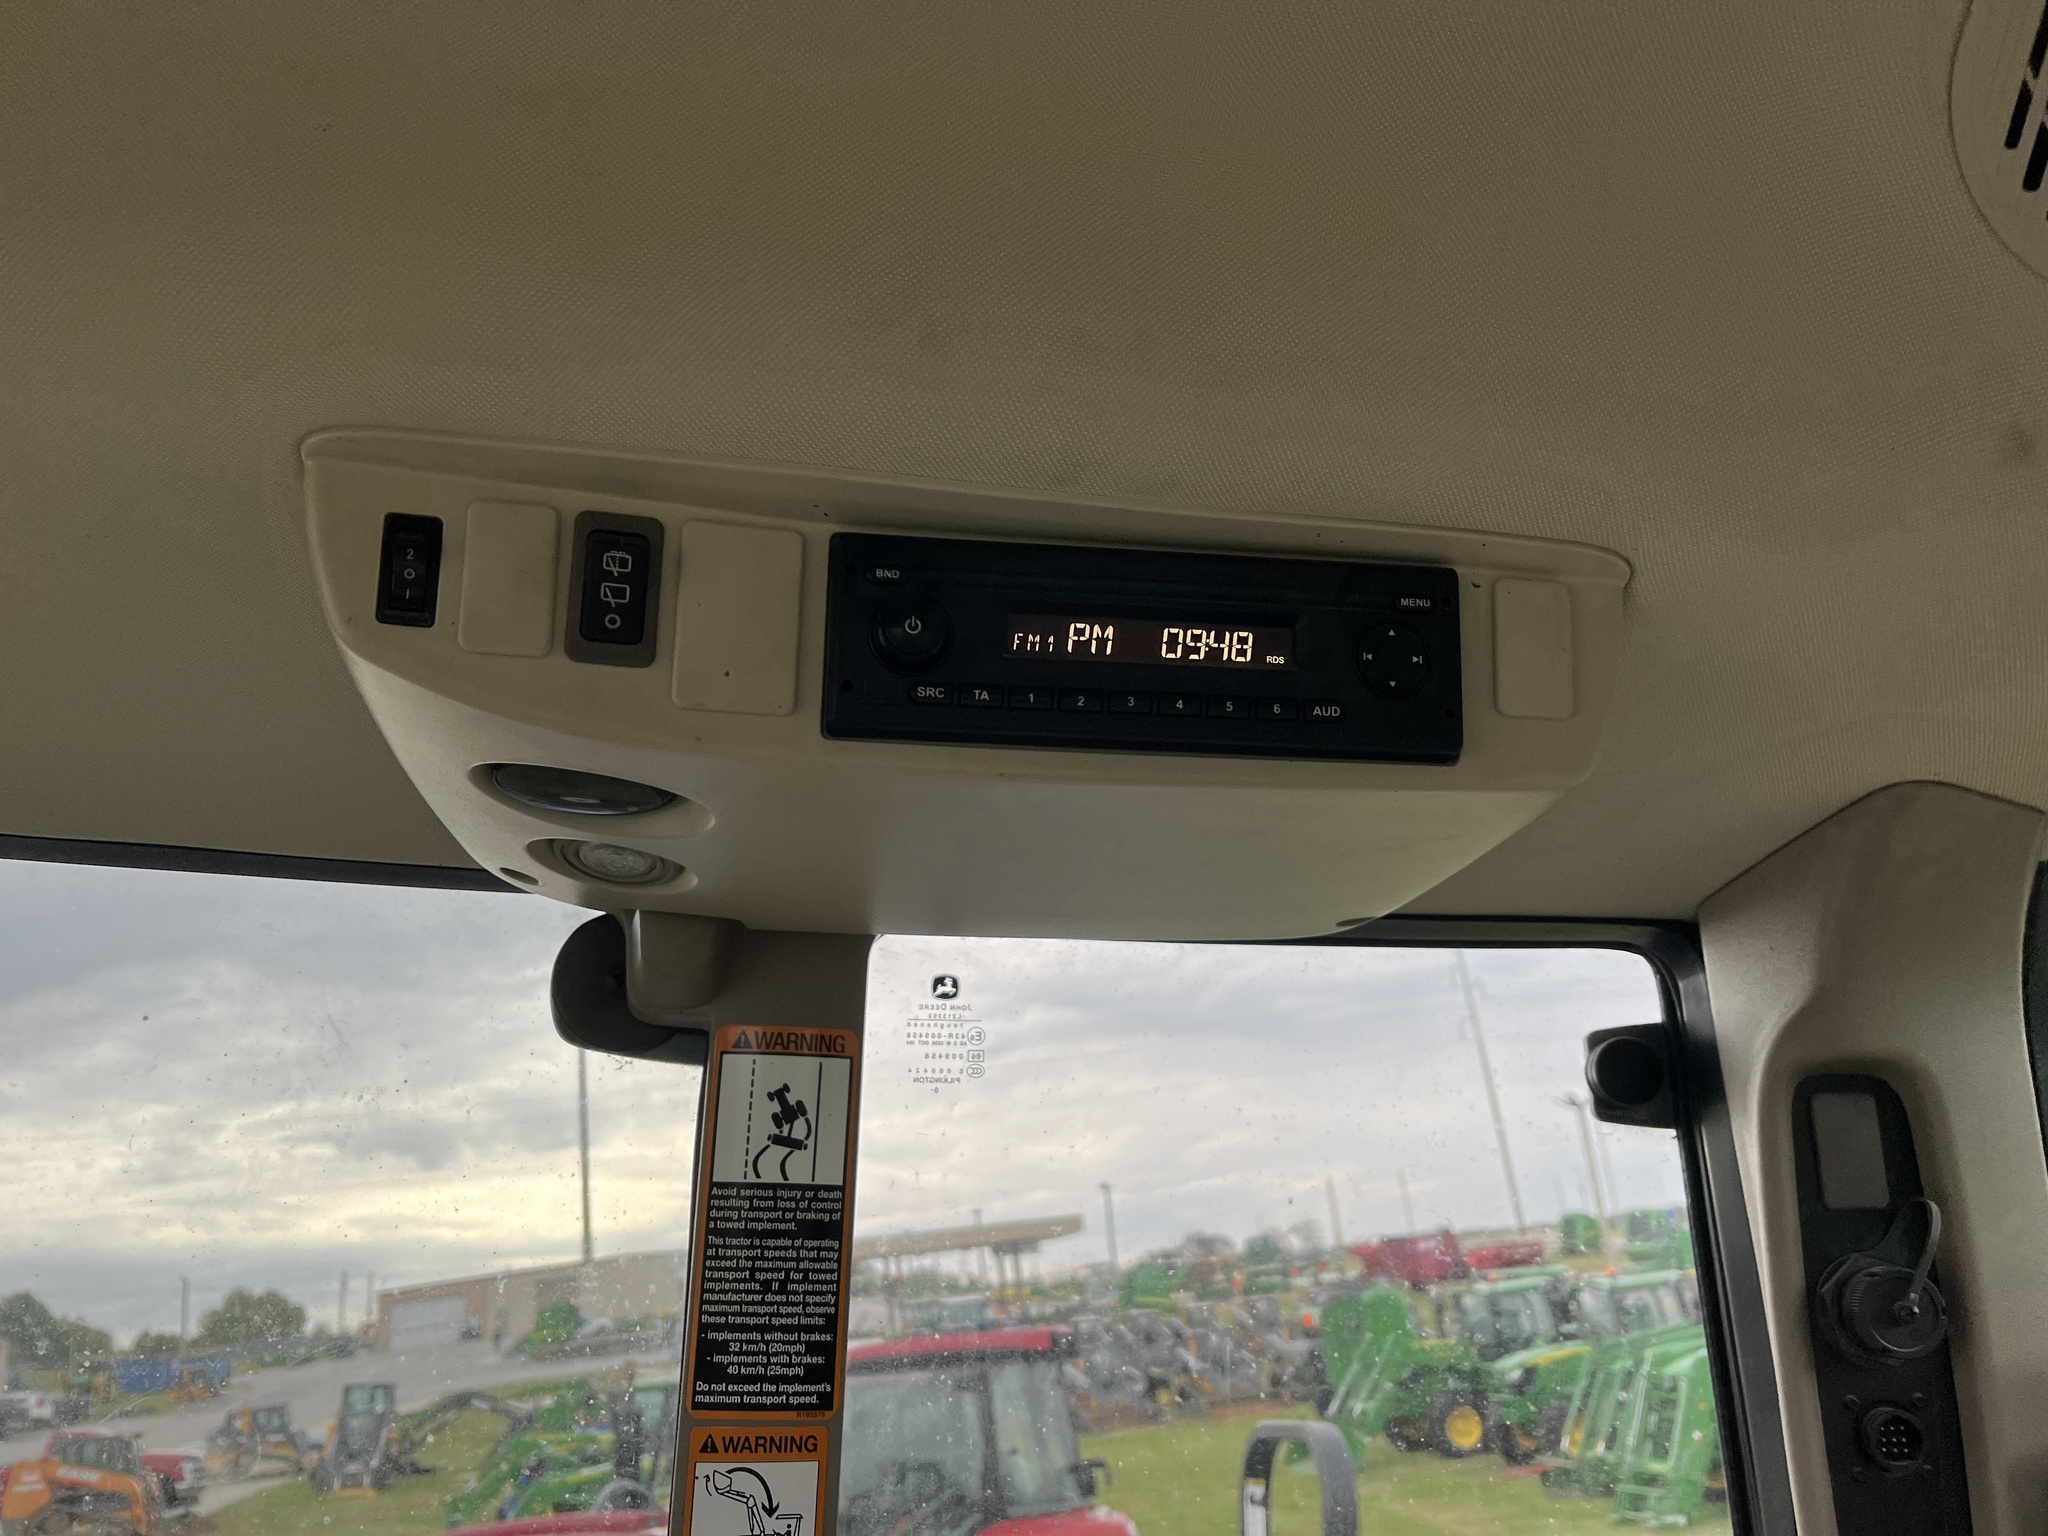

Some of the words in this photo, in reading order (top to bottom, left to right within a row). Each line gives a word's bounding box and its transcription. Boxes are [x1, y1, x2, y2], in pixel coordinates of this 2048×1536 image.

[407, 549, 414, 560] 2
[876, 569, 899, 578] BND
[1400, 598, 1430, 607] MENU
[1013, 633, 1054, 652] FM1
[1067, 622, 1114, 655] PM
[1266, 655, 1285, 664] RDS
[917, 686, 945, 698] SRC
[973, 690, 990, 701] TA
[1028, 693, 1034, 703] 1
[1078, 696, 1084, 706] 2
[1127, 696, 1134, 707] 3
[1176, 700, 1184, 710] 4
[1226, 702, 1233, 712] 5
[1274, 704, 1281, 714] 6
[1312, 706, 1340, 717] AUD
[754, 1031, 845, 1053] WARNING
[711, 1187, 736, 1196] Avoid
[740, 1187, 773, 1196] serious
[777, 1188, 802, 1199] injury
[818, 1189, 842, 1198] death
[711, 1198, 749, 1208] resulting
[753, 1199, 774, 1208] from
[777, 1200, 795, 1208] loss
[799, 1200, 808, 1208] of
[811, 1201, 842, 1209] control
[710, 1209, 738, 1219] during
[741, 1210, 782, 1220] transport
[797, 1211, 829, 1221] braking
[832, 1212, 841, 1220] of
[717, 1220, 744, 1228] towed
[748, 1221, 797, 1231] implement.
[708, 1236, 723, 1245] This
[726, 1236, 752, 1245] tractor
[753, 1237, 760, 1245] is
[762, 1237, 792, 1247] capable
[794, 1238, 802, 1246] of
[804, 1239, 839, 1249] operating
[719, 1248, 761, 1258] transport
[764, 1249, 797, 1258] speeds
[800, 1250, 817, 1258] that
[820, 1252, 838, 1260] may
[706, 1259, 736, 1267] exceed
[739, 1259, 752, 1267] the
[755, 1260, 796, 1268] maximum
[799, 1261, 838, 1269] allowable
[705, 1270, 749, 1280] transport
[755, 1271, 784, 1280] speed
[809, 1272, 837, 1280] towed
[704, 1281, 763, 1291] implements.
[772, 1282, 779, 1290] If
[787, 1282, 836, 1293] implement
[703, 1292, 763, 1301] manufacturer
[765, 1293, 786, 1302] does
[789, 1294, 803, 1302] not
[805, 1294, 835, 1304] specify
[702, 1303, 740, 1312] maximum
[742, 1304, 777, 1314] transport
[779, 1305, 804, 1315] speed,
[702, 1314, 726, 1322] these
[728, 1315, 769, 1325] transport
[771, 1316, 798, 1325] speed
[800, 1316, 825, 1325] limits:
[707, 1330, 761, 1341] implements
[764, 1332, 798, 1340] without
[801, 1332, 833, 1341] brakes:
[729, 1342, 740, 1351] 32
[742, 1343, 766, 1351] km/h
[769, 1343, 805, 1353] (20mph)
[713, 1354, 767, 1364] implements
[770, 1354, 789, 1363] with
[792, 1355, 825, 1363] brakes:
[727, 1365, 738, 1374] 40
[741, 1366, 764, 1374] km/h
[767, 1366, 803, 1376] (25mph)
[696, 1382, 709, 1391] Do
[711, 1382, 725, 1391] not
[728, 1383, 760, 1391] exceed
[763, 1383, 776, 1392] the
[779, 1383, 831, 1393] implement's
[695, 1394, 740, 1403] maximum
[743, 1395, 786, 1405] transport
[789, 1395, 819, 1405] speed.
[722, 1436, 818, 1454] WARNING
